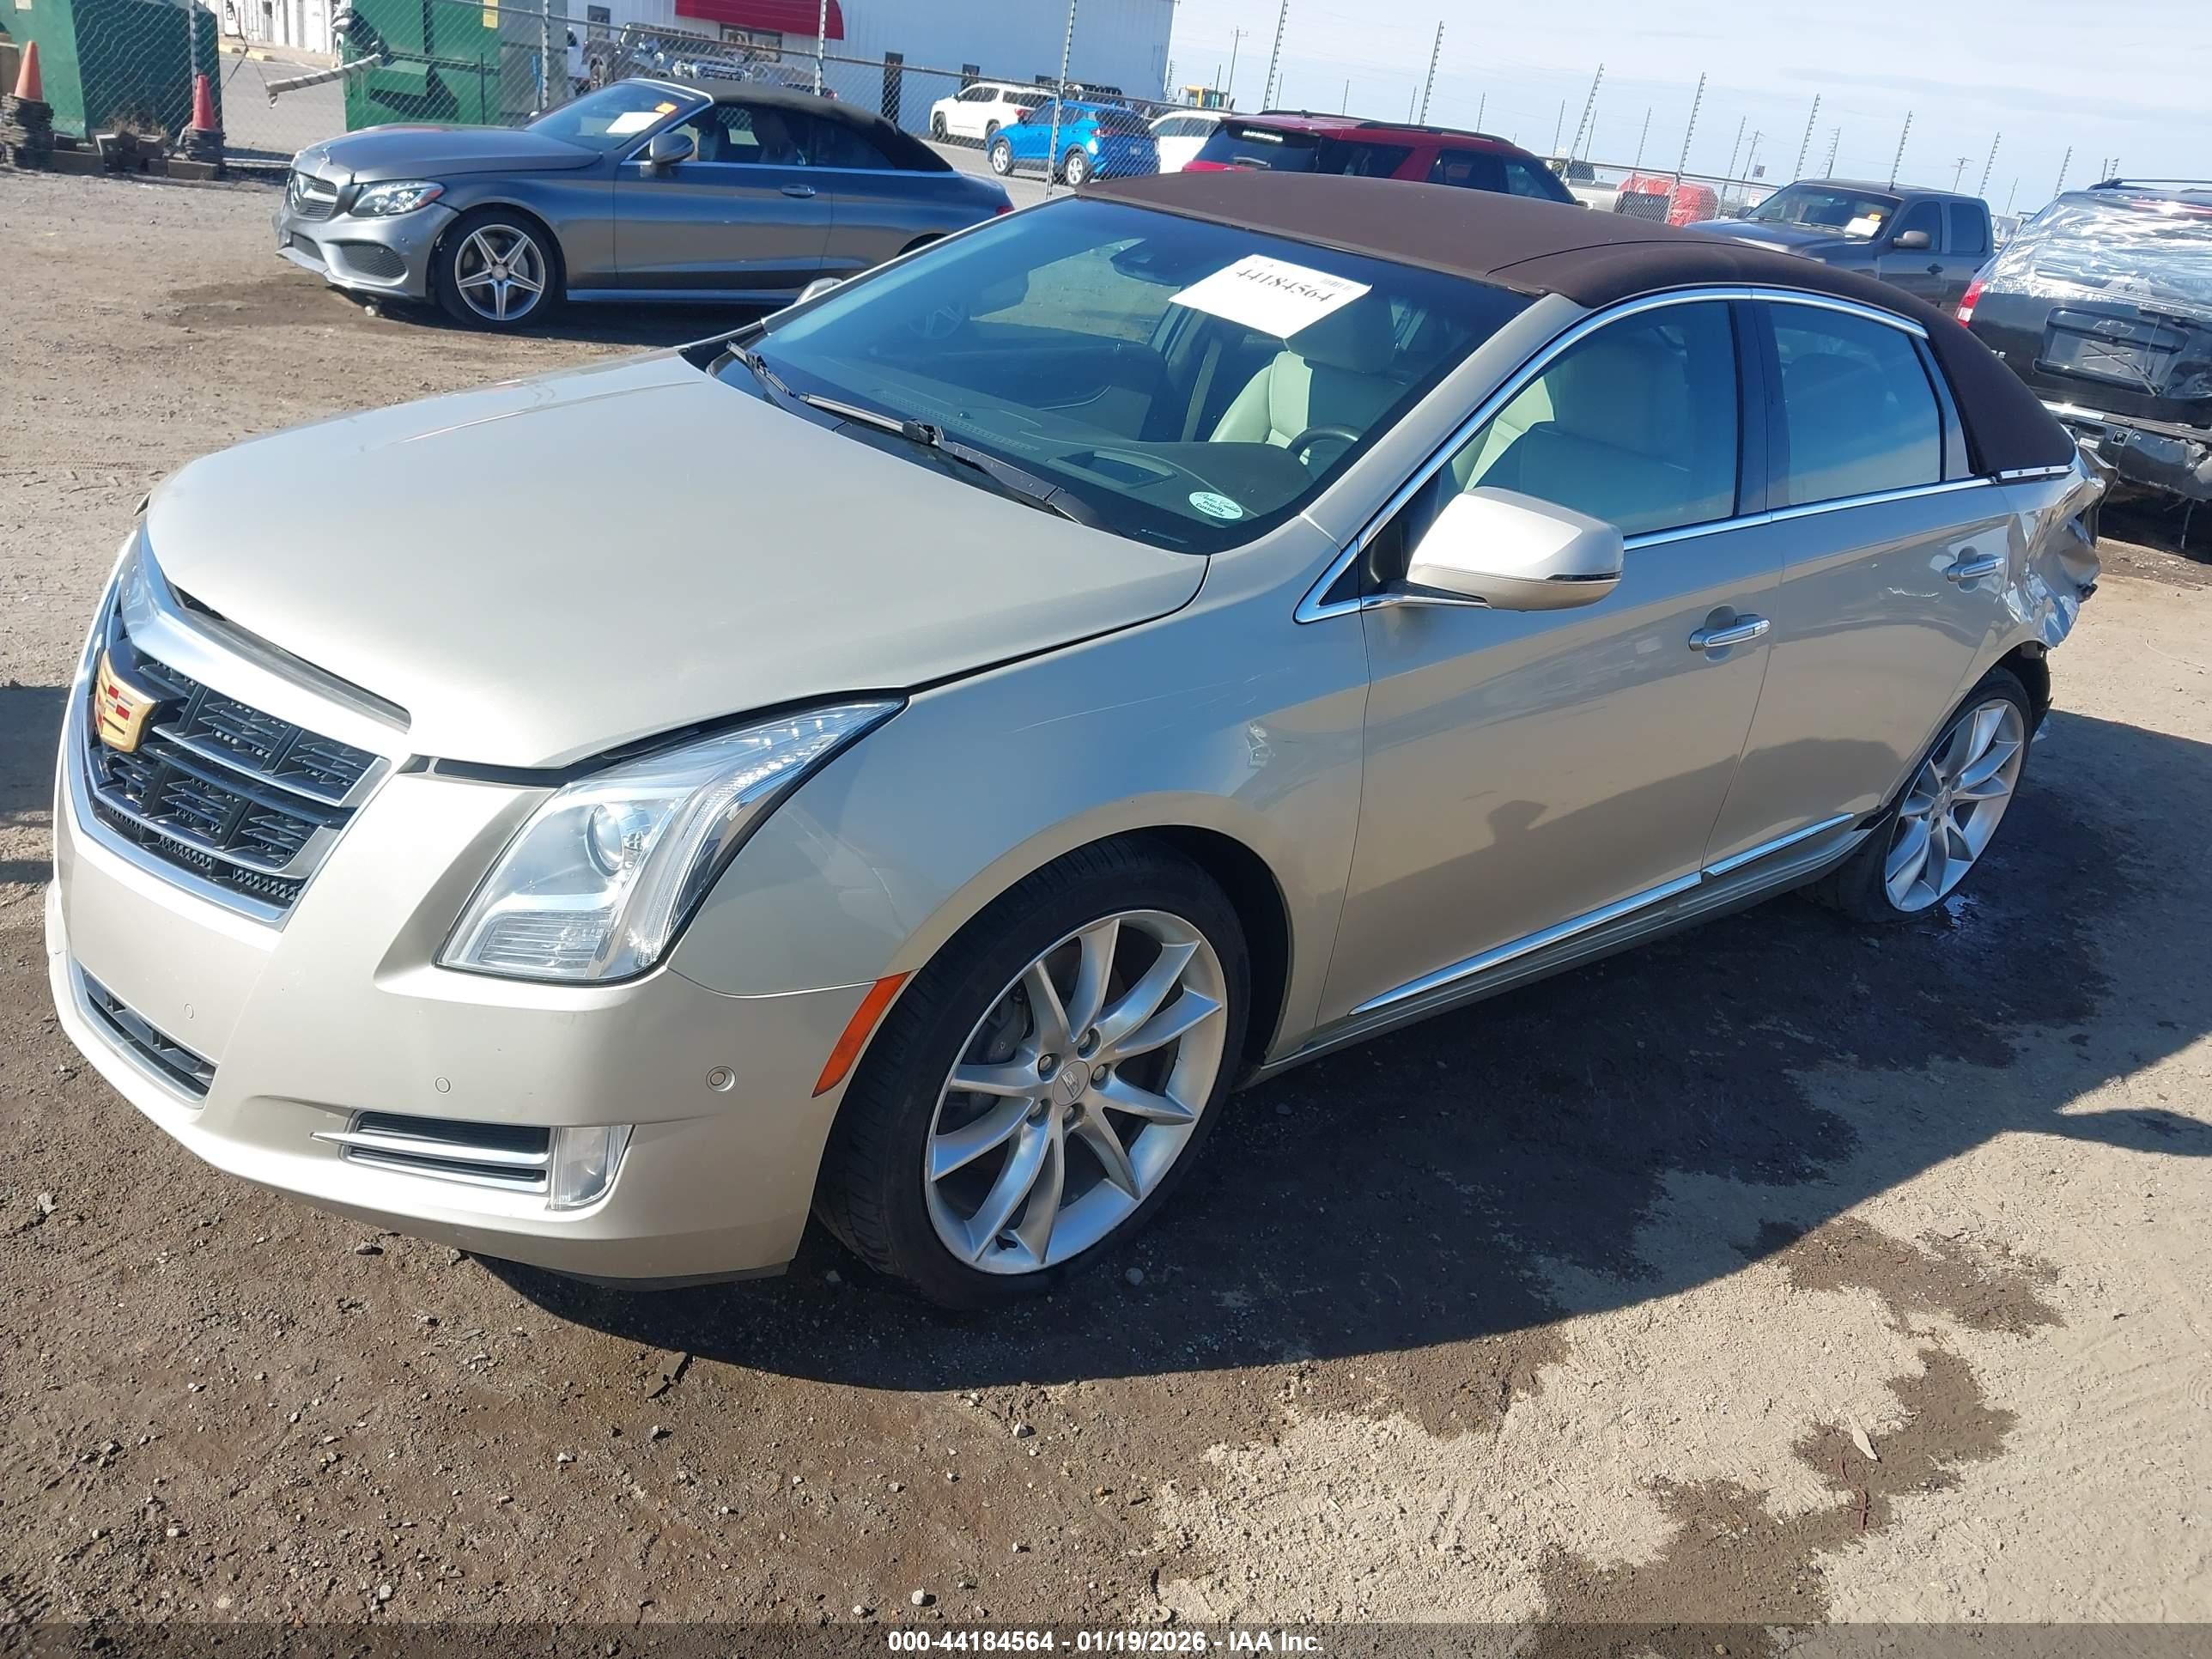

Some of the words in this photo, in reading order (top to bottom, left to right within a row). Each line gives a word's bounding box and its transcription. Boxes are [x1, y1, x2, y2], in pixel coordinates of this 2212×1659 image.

[1237, 269, 1335, 302] 44184564
[1196, 502, 1225, 517] Customer
[1203, 501, 1224, 513] Priority
